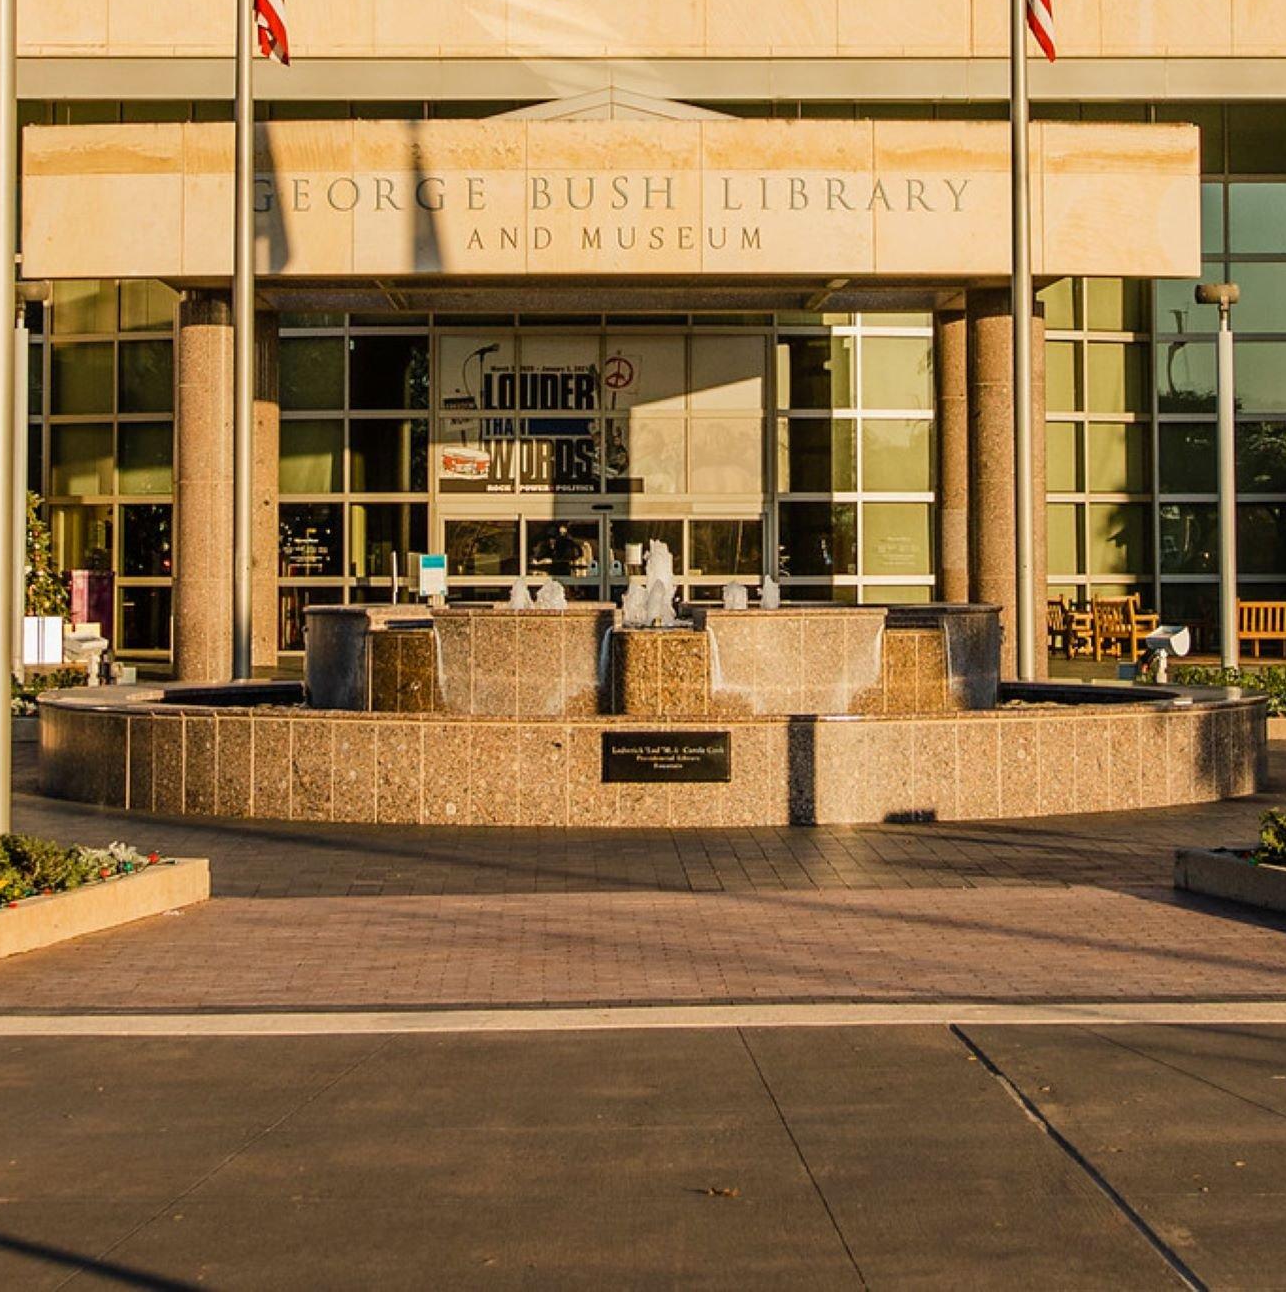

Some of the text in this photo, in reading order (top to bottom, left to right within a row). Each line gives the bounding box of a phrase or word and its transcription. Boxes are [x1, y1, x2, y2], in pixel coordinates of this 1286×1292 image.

[253, 176, 972, 213] GEORGE BUSH LIBRARY
[466, 225, 763, 251] AND MUSEUM
[483, 372, 595, 410] LOUDER
[482, 439, 595, 480] WORDS
[556, 484, 595, 492] POLITICS
